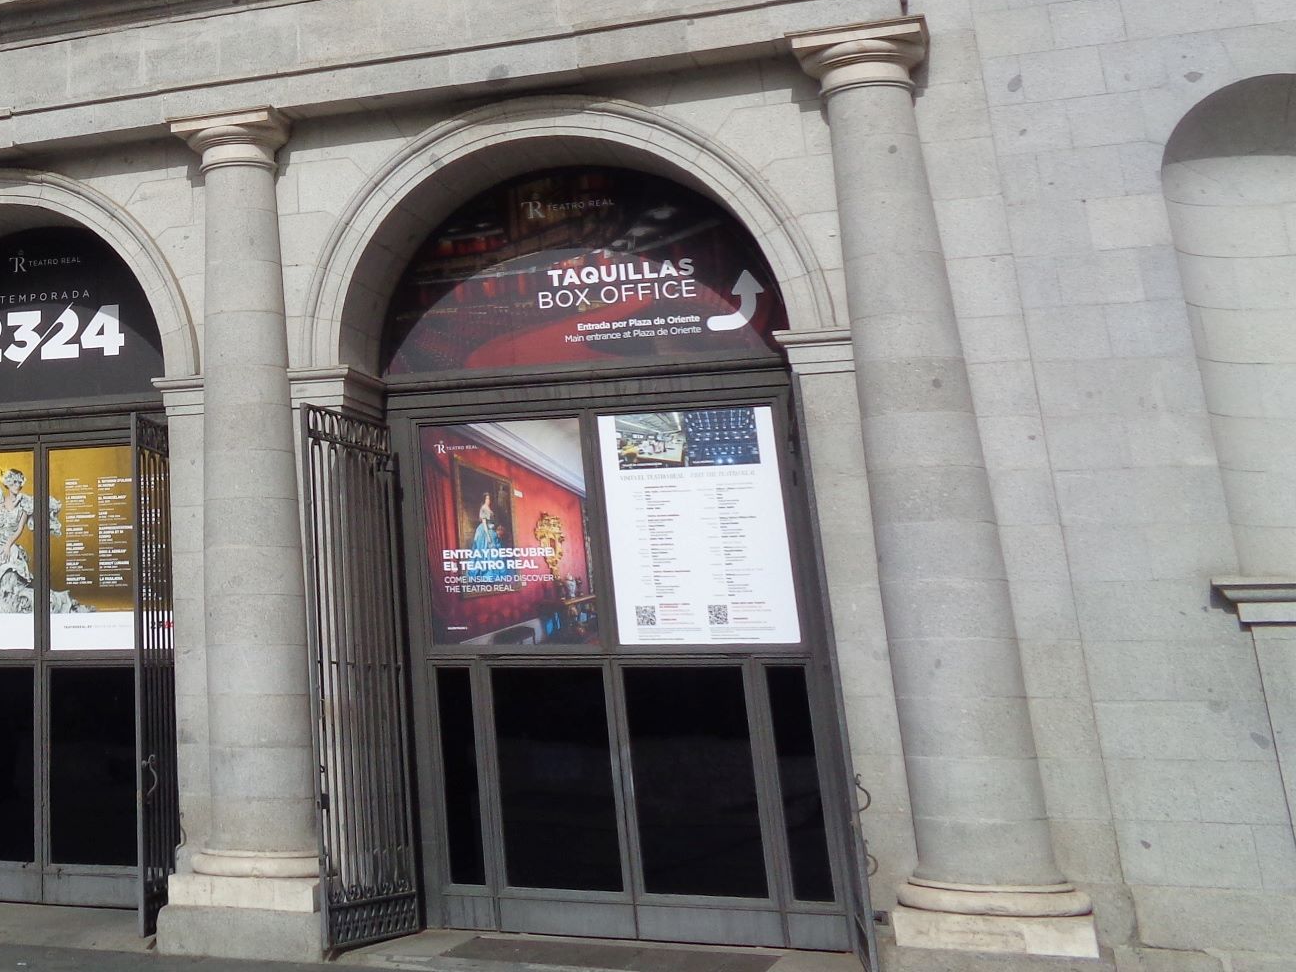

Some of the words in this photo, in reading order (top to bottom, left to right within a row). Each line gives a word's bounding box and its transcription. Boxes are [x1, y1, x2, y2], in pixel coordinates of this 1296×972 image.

[547, 201, 585, 211] TEATRO
[588, 198, 615, 207] REAL
[28, 258, 58, 267] TEATRO
[61, 256, 81, 264] REAL
[547, 257, 694, 287] TAQUILLAS
[0, 289, 90, 304] TEMPORADA
[538, 288, 591, 309] BOX
[600, 279, 696, 304] OFFICE
[577, 320, 610, 331] Entrada
[612, 321, 627, 330] por
[629, 318, 652, 327] Plaza
[654, 317, 665, 325] de
[667, 315, 701, 325] Oriente
[565, 332, 584, 343] Main
[586, 332, 621, 341] entrance
[623, 330, 631, 338] at
[633, 328, 655, 337] Plaza
[657, 327, 668, 336] de
[670, 325, 702, 335] Oriente
[443, 549, 483, 560] ENTRA
[490, 547, 554, 558] DESCUBRE
[443, 561, 457, 571] EL
[460, 560, 504, 571] TEATRO
[507, 560, 538, 570] REAL
[444, 576, 467, 584] COME
[469, 575, 495, 583] INSIDE
[495, 574, 513, 583] AND
[514, 573, 554, 583] DISCOVER
[445, 585, 460, 593] THE
[462, 584, 497, 593] TEATRO
[498, 583, 515, 592] REAL
